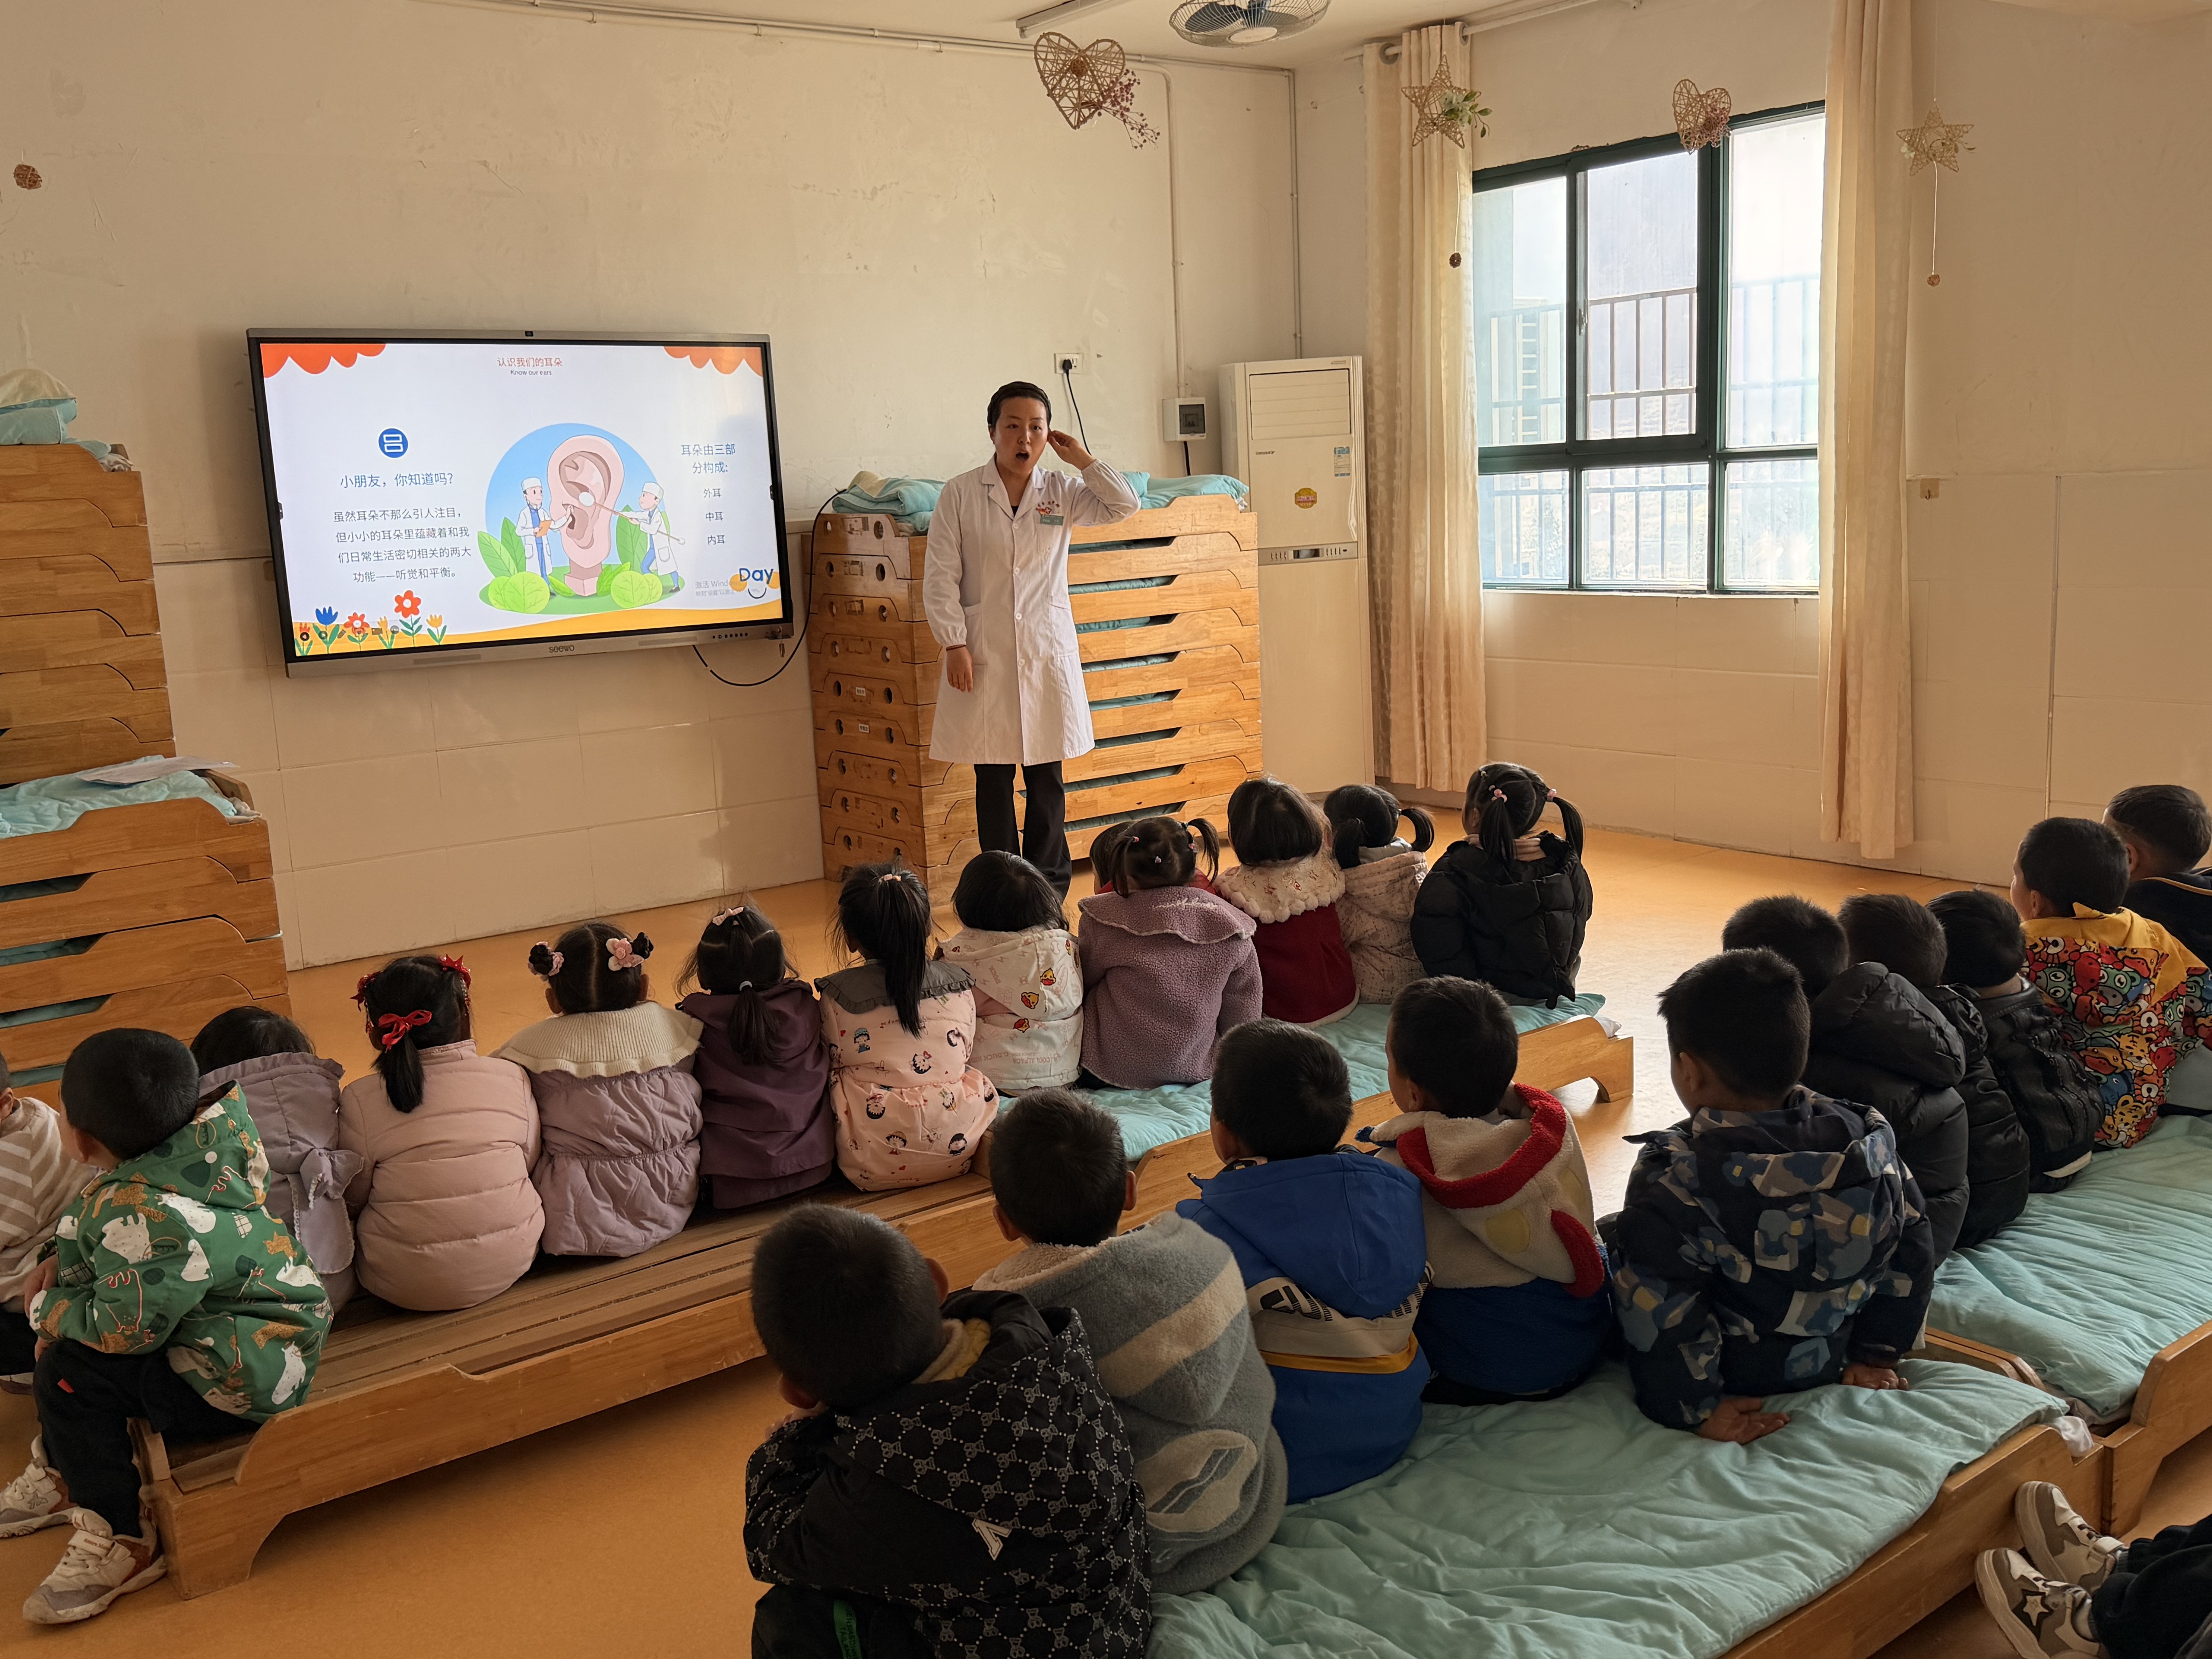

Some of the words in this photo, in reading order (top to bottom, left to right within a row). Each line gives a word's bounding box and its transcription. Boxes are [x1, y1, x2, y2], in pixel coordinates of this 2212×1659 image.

[497, 357, 562, 367] 认识我们的耳朵
[681, 443, 736, 456] 耳朵由三部
[703, 488, 721, 498] 外耳
[706, 512, 723, 521] 中耳
[336, 526, 469, 543] 但小小的耳朵里蕴藏着和我
[707, 535, 726, 545] 内耳
[338, 546, 471, 563] 们日常生活密切相关的两大
[739, 568, 774, 585] Day
[549, 645, 575, 653] seewo
